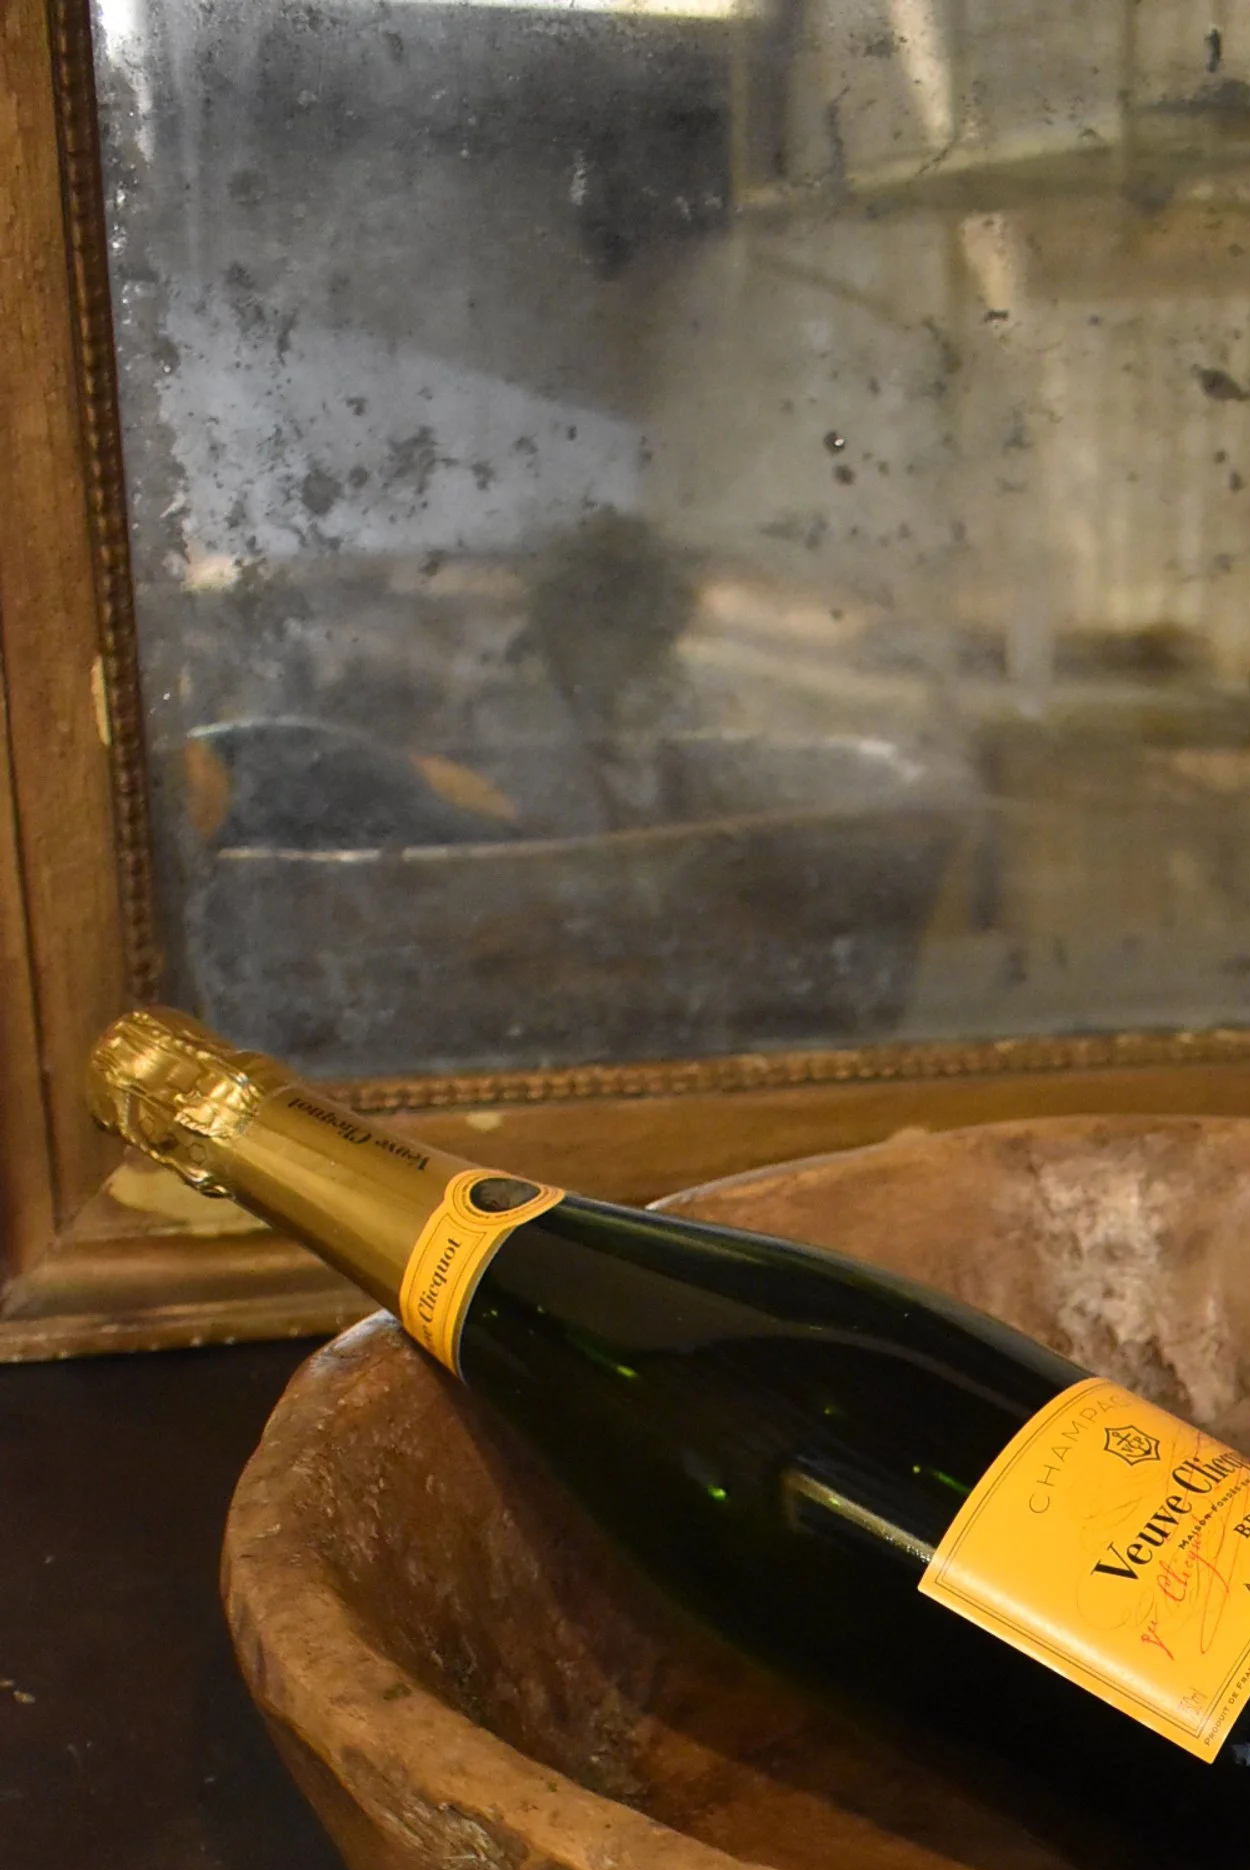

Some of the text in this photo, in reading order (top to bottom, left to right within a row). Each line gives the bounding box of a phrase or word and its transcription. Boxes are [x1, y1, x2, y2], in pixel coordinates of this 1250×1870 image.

[416, 1237, 462, 1323] Clicquot
[1090, 1494, 1192, 1580] Veuve
[1203, 1705, 1231, 1746] PRODUIT
[1228, 1690, 1240, 1705] DE
